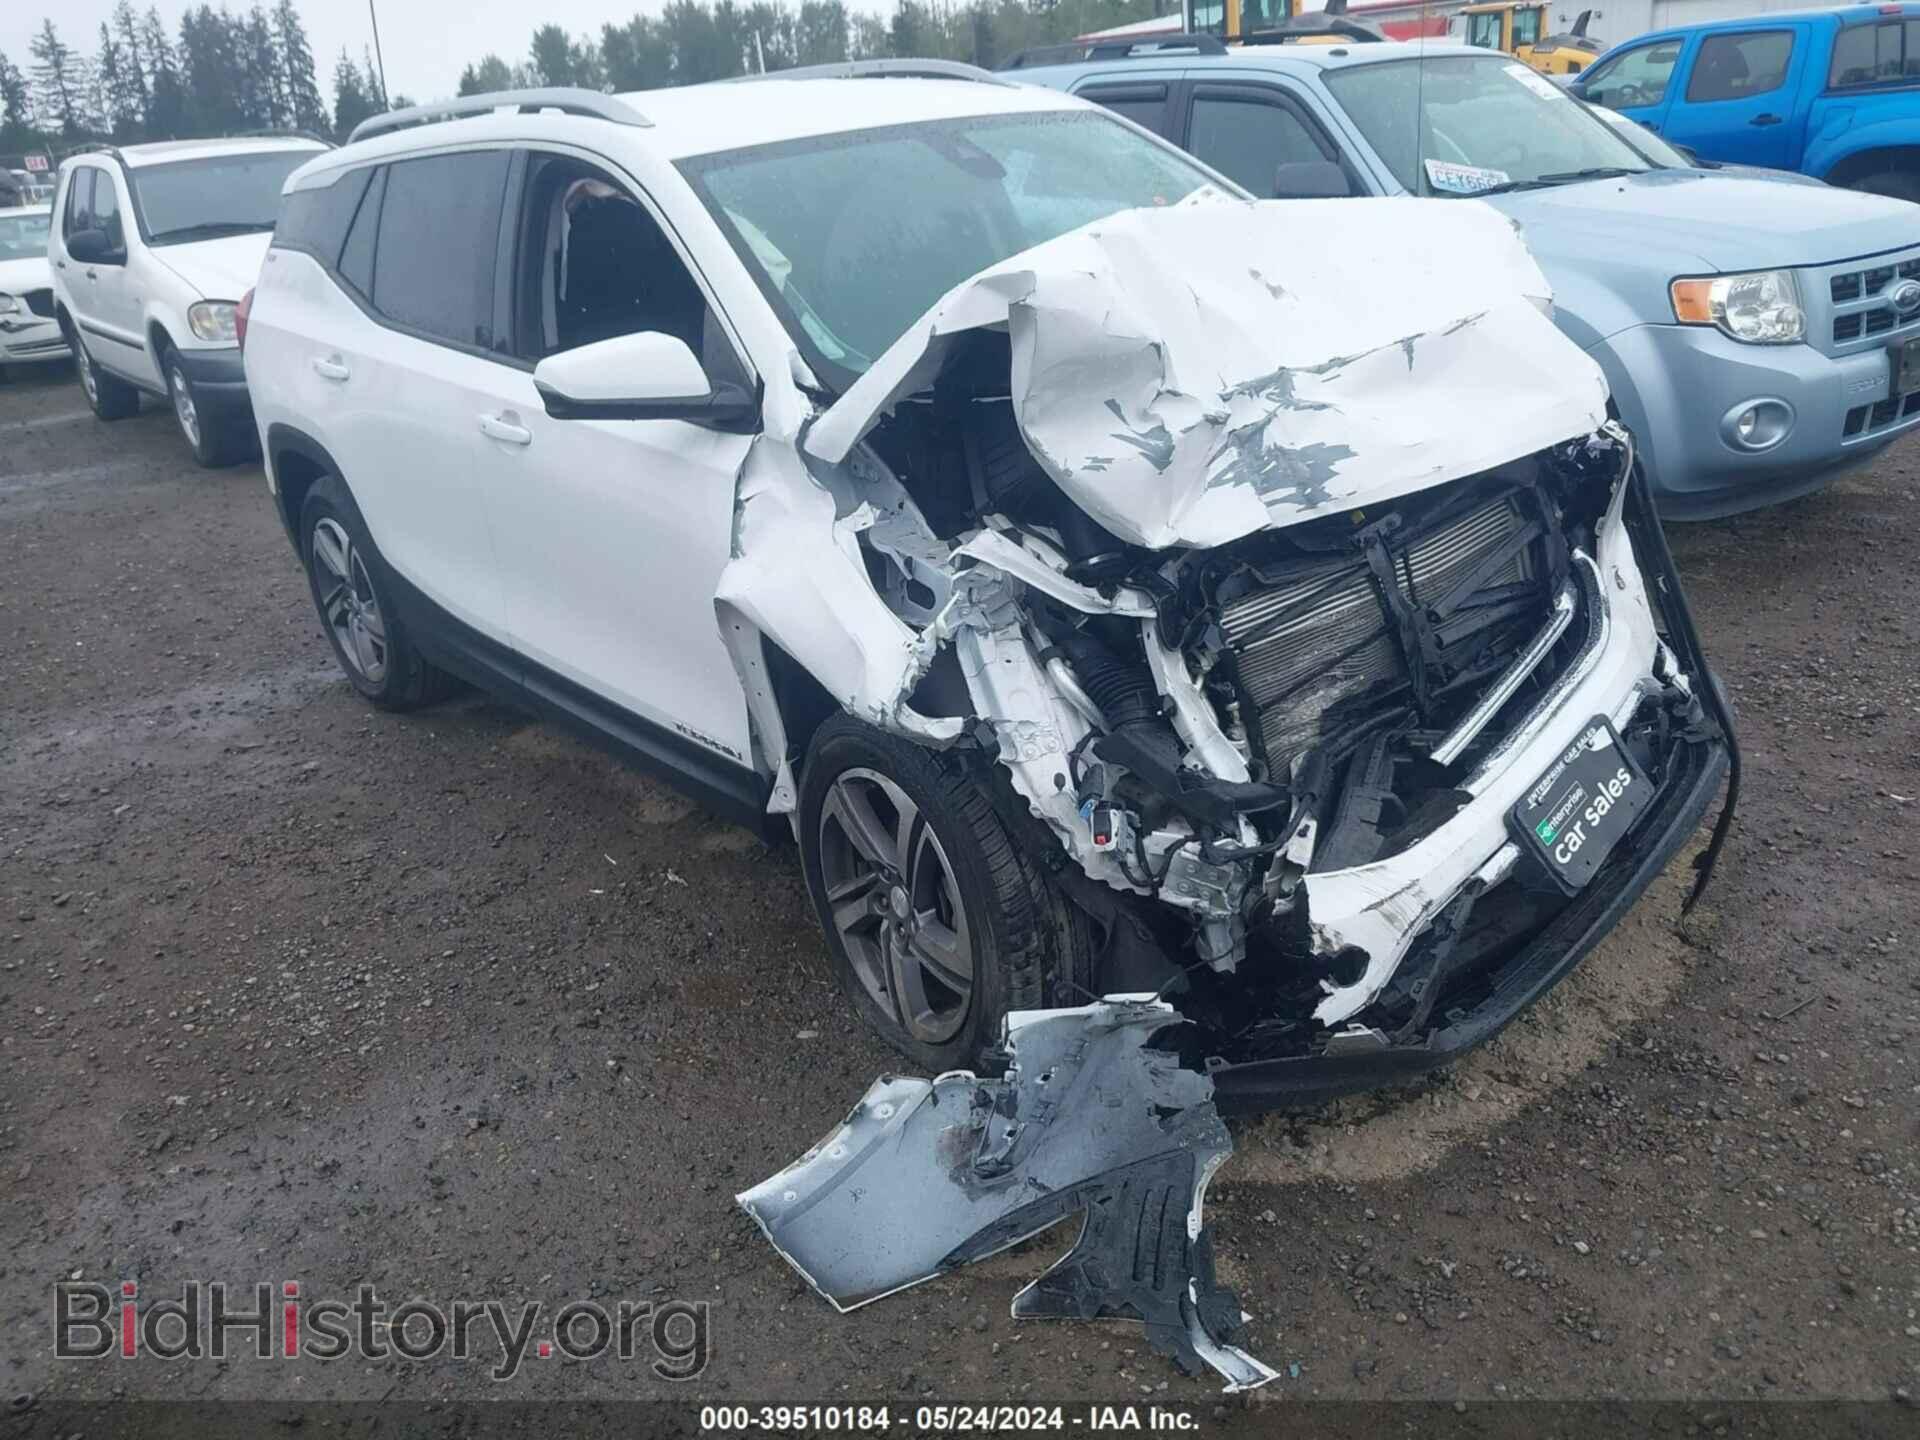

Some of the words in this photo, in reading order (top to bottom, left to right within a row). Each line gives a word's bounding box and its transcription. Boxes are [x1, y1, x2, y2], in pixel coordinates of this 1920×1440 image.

[1527, 760, 1565, 808] ENTERPRISE
[1563, 745, 1579, 763] CAR
[1541, 788, 1584, 839] enterprise
[1555, 820, 1586, 864] car
[1584, 767, 1632, 827] sales
